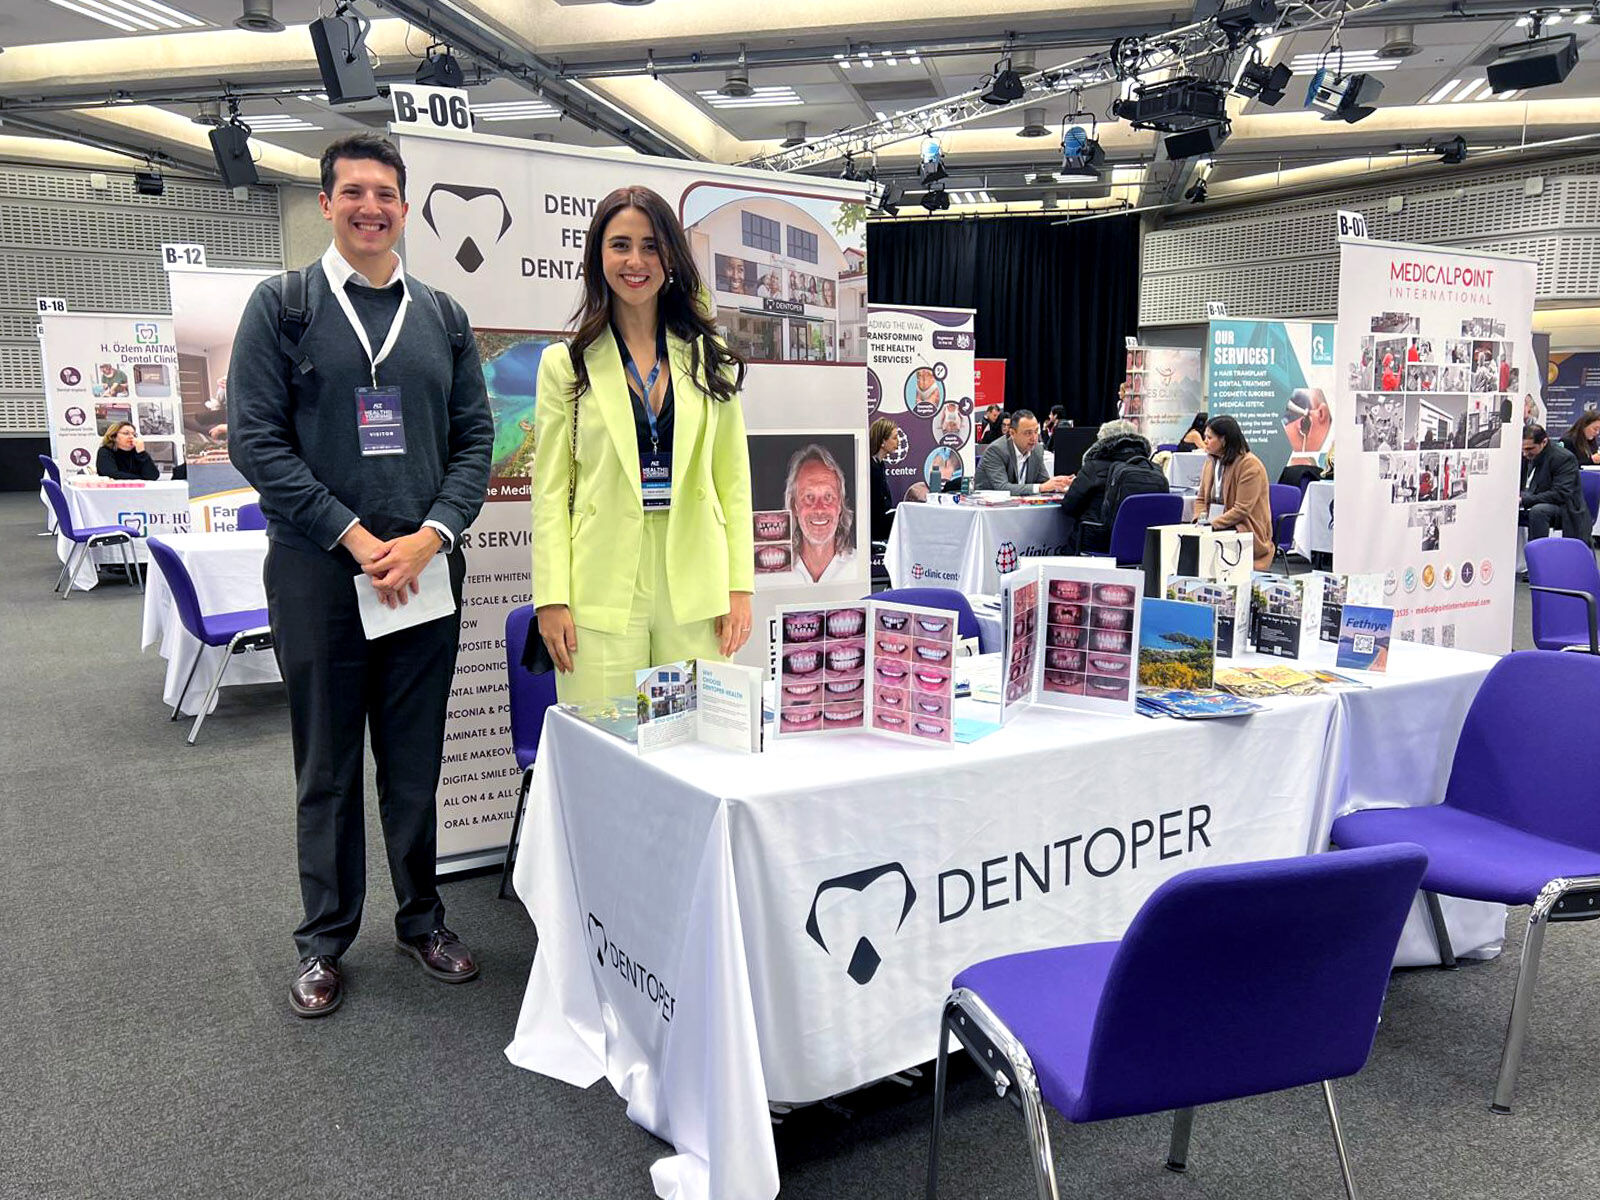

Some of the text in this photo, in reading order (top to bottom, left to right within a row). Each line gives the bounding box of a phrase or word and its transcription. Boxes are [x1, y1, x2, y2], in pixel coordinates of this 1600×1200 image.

[394, 91, 469, 129] B-06
[545, 194, 596, 217] DENT
[1340, 215, 1365, 237] B-07
[165, 247, 203, 264] B-12
[522, 258, 584, 280] DENTA
[1390, 261, 1494, 288] MEDICALPOINT
[1389, 287, 1492, 305] INTERNATIONAL
[39, 300, 65, 311] B-18
[868, 320, 891, 330] ADING
[893, 320, 905, 330] THE
[867, 332, 923, 342] RANSFORMING
[1214, 330, 1235, 345] OUR
[101, 342, 176, 353] H. Özlem ANTAK
[871, 343, 915, 353] THE HEALTH
[121, 355, 151, 363] Dental
[873, 354, 912, 364] SERVICES!
[1214, 347, 1269, 365] SERVICES
[891, 466, 917, 476] center
[501, 485, 532, 496] Medit
[149, 510, 191, 524] DT. HÜ
[213, 506, 238, 517] Fa
[173, 526, 191, 534] AN
[214, 521, 238, 532] He
[462, 530, 532, 549] R SERVI
[467, 572, 532, 584] TEETH WHITENI
[924, 568, 960, 581] clinic cent
[471, 595, 499, 606] SCALE
[502, 595, 508, 603] &
[511, 594, 533, 603] CLEA
[461, 620, 477, 629] OW
[459, 640, 506, 652] POSITE BO
[457, 661, 507, 674] HODONTIC
[451, 684, 510, 697] NTAL IMPLAN
[725, 690, 743, 699] HEALTH
[448, 705, 510, 719] RCONIA & PO
[445, 726, 511, 741] AMINATE & EM
[441, 747, 512, 763] SMILE MAKEOV
[443, 767, 521, 785] DIGITAL SMILE DE
[443, 797, 459, 807] ALL
[462, 795, 477, 804] ON
[480, 793, 486, 801] 4
[488, 792, 494, 800] &
[497, 789, 513, 798] ALL
[444, 810, 514, 829] ORAL & MAXILL
[938, 804, 1212, 924] DENTOPER
